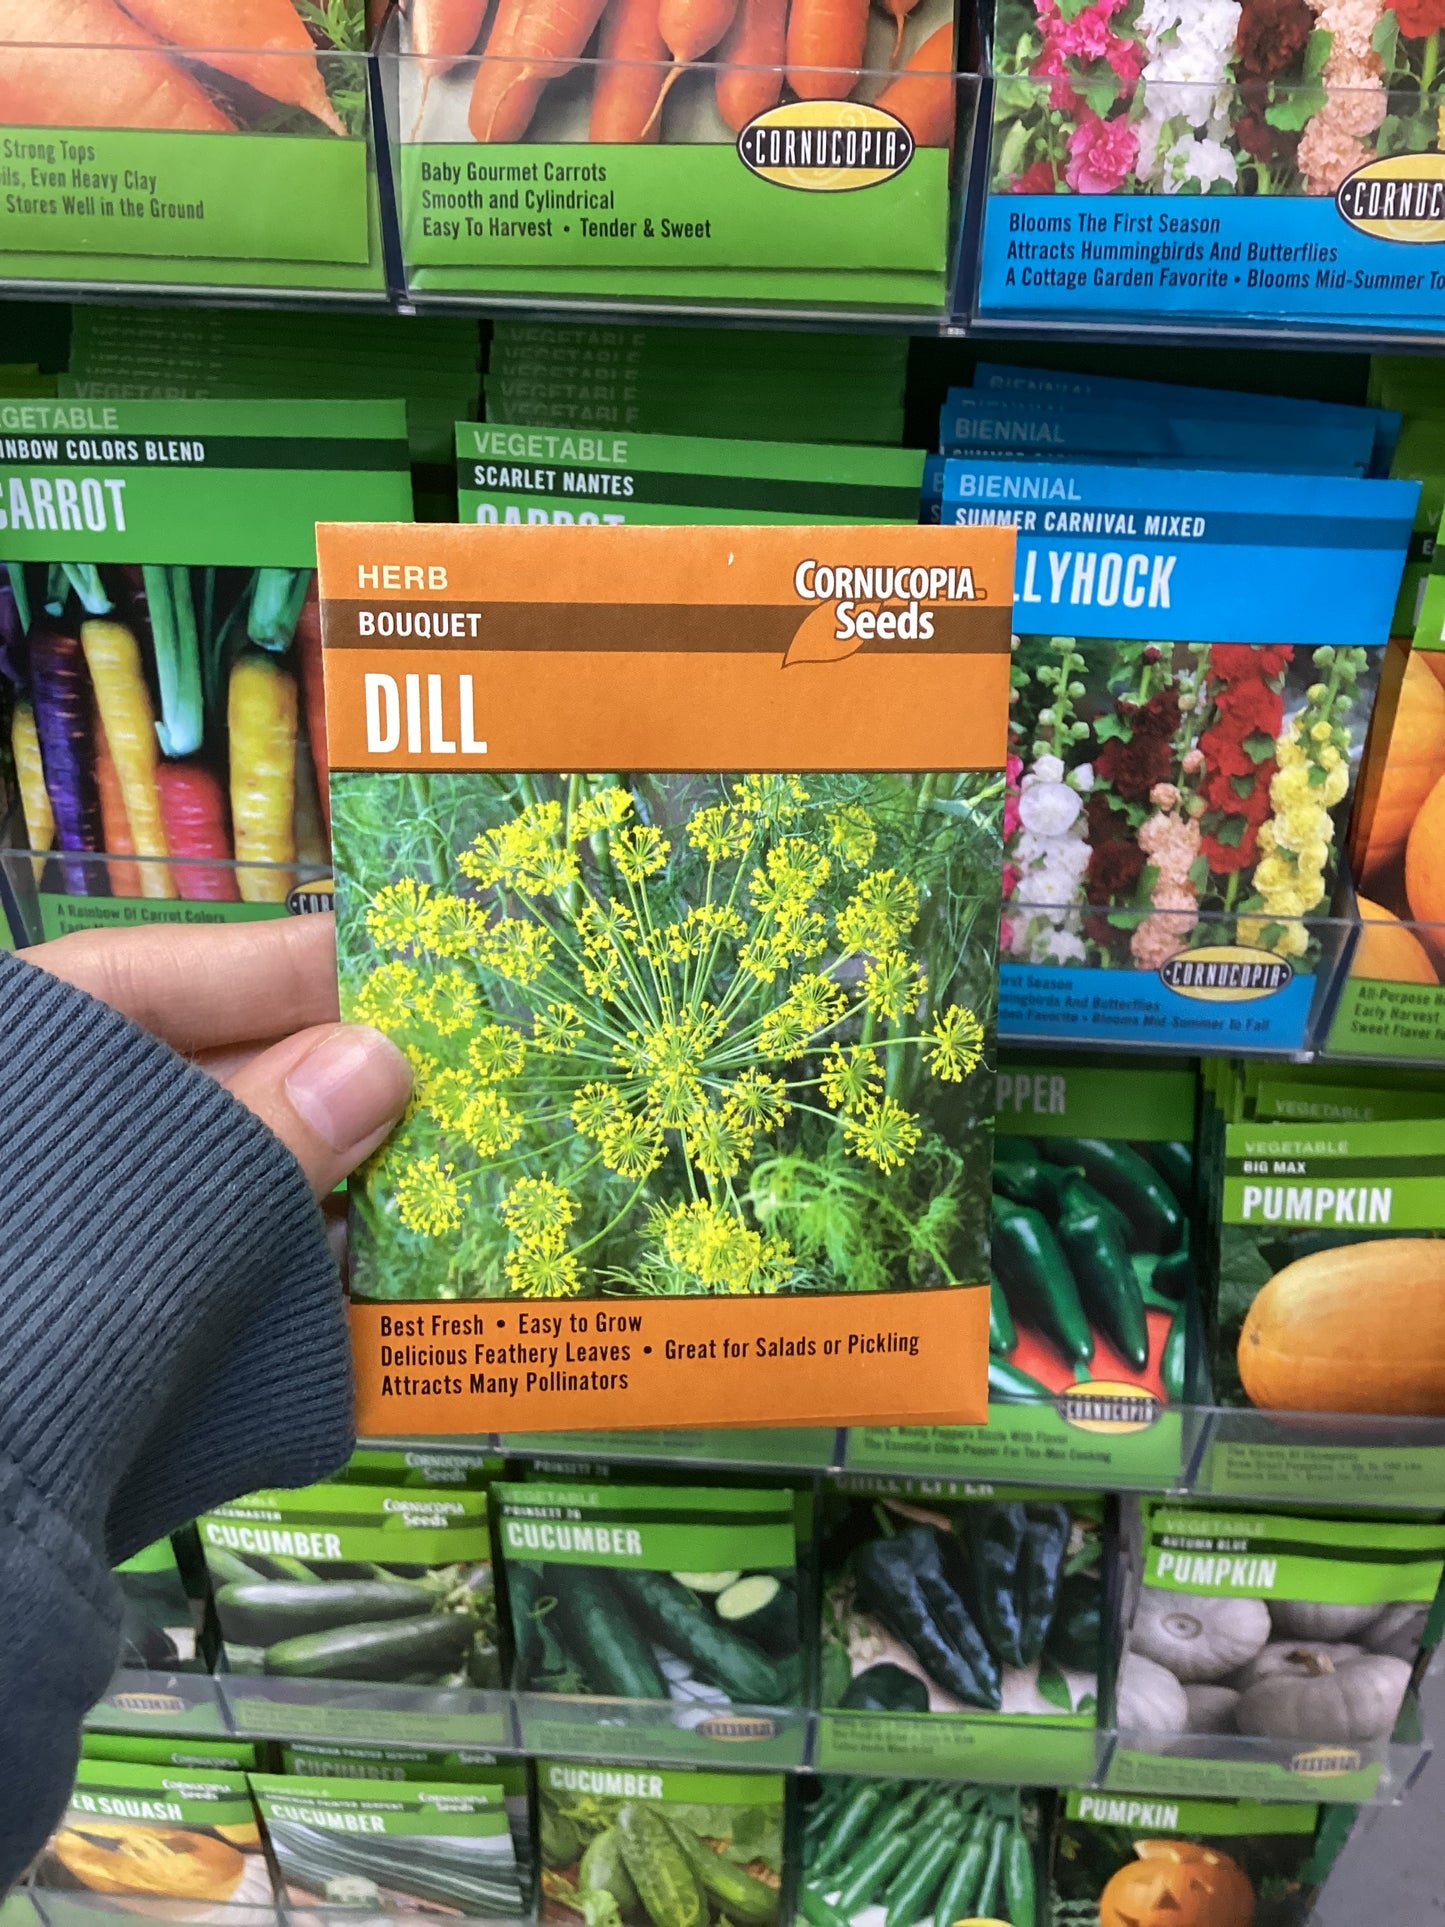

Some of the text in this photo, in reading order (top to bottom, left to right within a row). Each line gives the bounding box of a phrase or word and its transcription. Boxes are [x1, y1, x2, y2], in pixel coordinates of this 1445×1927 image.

[4, 138, 96, 165] Strong Tops
[755, 128, 897, 167] CORNUCOPIA
[31, 167, 66, 188] Even
[72, 168, 118, 193] Heavy
[124, 170, 157, 195] Clay
[422, 162, 606, 185] Baby Gourmet Carrots
[6, 194, 204, 220] Stores Well in the Ground
[422, 190, 614, 213] Smooth and Cylindrical
[1354, 182, 1443, 217] CORNUC
[423, 217, 712, 240] Easy To Harvest Tender & Sweet
[1010, 213, 1220, 234] Blooms The First Season
[1007, 240, 1338, 264] Attracts Hummingbirds And Butterflies
[1005, 268, 1016, 286] A
[1022, 268, 1087, 290] Cottage
[1093, 268, 1152, 286] Garden
[1160, 268, 1228, 288] Favorite
[1247, 268, 1310, 288] Blooms
[1315, 268, 1425, 289] Mid-Summer
[0, 406, 119, 430] GETABLE
[955, 417, 1065, 443] BIENNIAL
[66, 440, 139, 460] COLORS
[145, 440, 204, 462] BLEND
[474, 430, 628, 464] VEGETABLE
[474, 465, 634, 496] SCARLET NANTES
[959, 474, 1082, 500] BIENNIAL
[956, 508, 1037, 530] SUMMER
[1044, 512, 1136, 534] CARNIVAL
[1144, 516, 1206, 537] MIXED
[356, 564, 448, 590] HERB
[794, 559, 977, 600] CORNUCOPIA
[1014, 550, 1177, 608] LYHOCK
[358, 611, 482, 638] BOUQUET
[835, 600, 935, 640] Seeds
[364, 673, 488, 755] DILL
[57, 904, 66, 916] A
[68, 904, 120, 920] Rainbow
[141, 908, 182, 922] Carrot
[184, 910, 226, 923] Colors
[1172, 962, 1281, 988] CORNUCOPIA
[1390, 1006, 1440, 1024] Harvest
[1350, 1020, 1390, 1036] Sweet
[1393, 1024, 1430, 1040] Flavor
[1275, 1100, 1375, 1121] VEGETABLE
[1244, 1140, 1348, 1156] VEGETABLE
[1243, 1160, 1306, 1174] BIG MAX
[1242, 1186, 1392, 1224] PUMPKIN
[381, 1312, 642, 1338] Best Fresh Easy to Grow
[381, 1332, 920, 1368] Delicious Feathery Leaves Great for Salads or Pickling
[382, 1370, 628, 1398] Attracts Many Pollinators
[403, 1513, 448, 1528] Seeds
[206, 1524, 342, 1559] CUCUMBER
[506, 1522, 643, 1556] CUCUMBER
[1156, 1552, 1278, 1589] PUMPKIN
[550, 1766, 664, 1799] CUCUMBER
[99, 1796, 184, 1822] SQUASH
[270, 1804, 386, 1833] CUCUMBER
[1078, 1796, 1180, 1830] PUMPKIN
